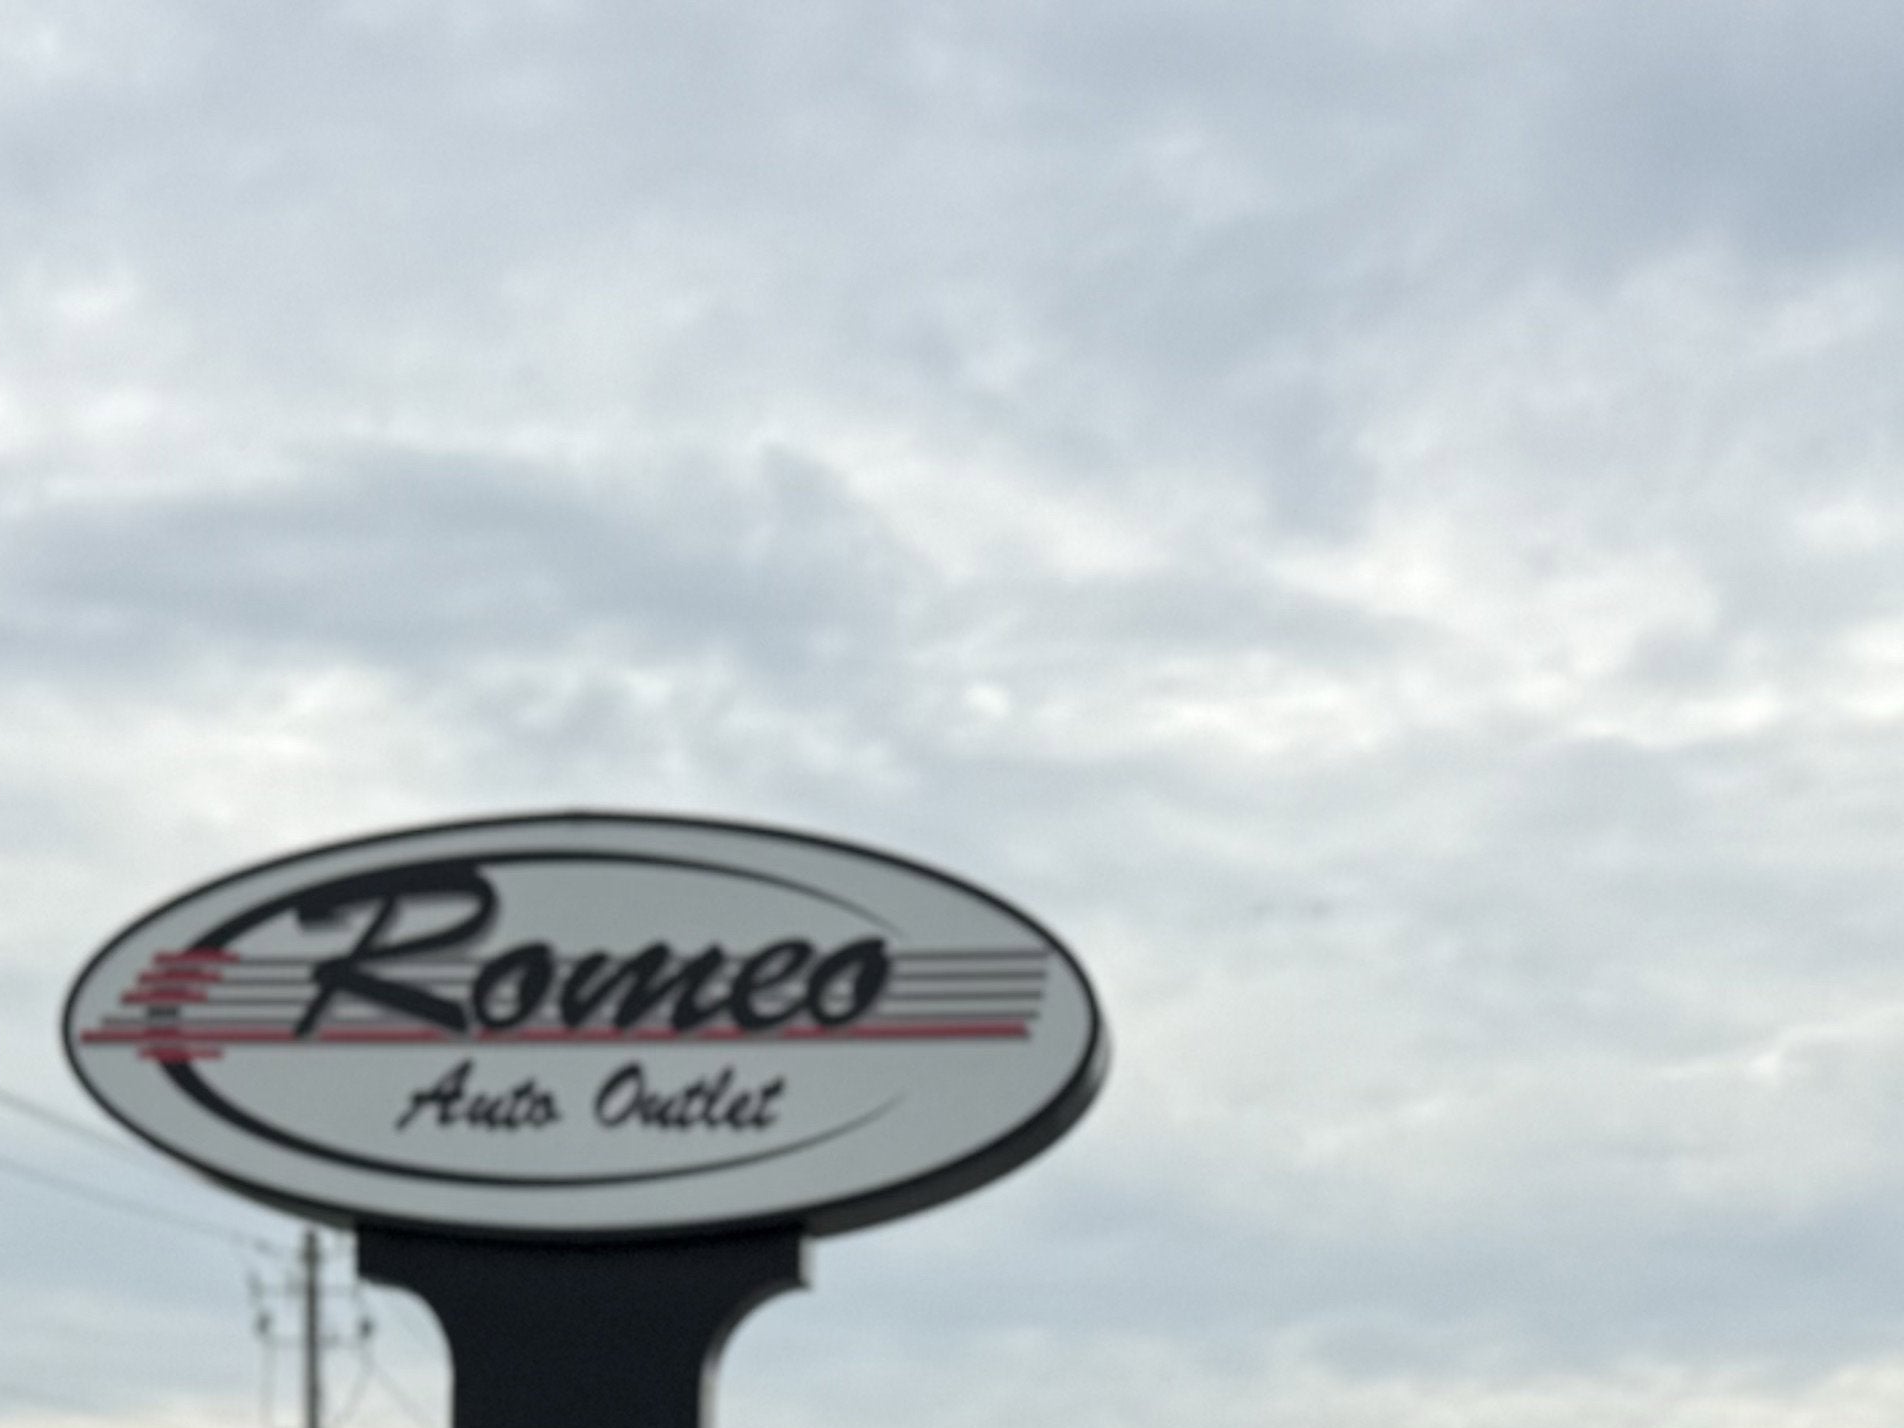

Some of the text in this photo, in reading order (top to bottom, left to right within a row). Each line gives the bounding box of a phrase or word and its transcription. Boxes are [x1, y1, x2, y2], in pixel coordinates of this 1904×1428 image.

[291, 856, 893, 1037] Romeo
[397, 1059, 786, 1133] Auto Outlet
